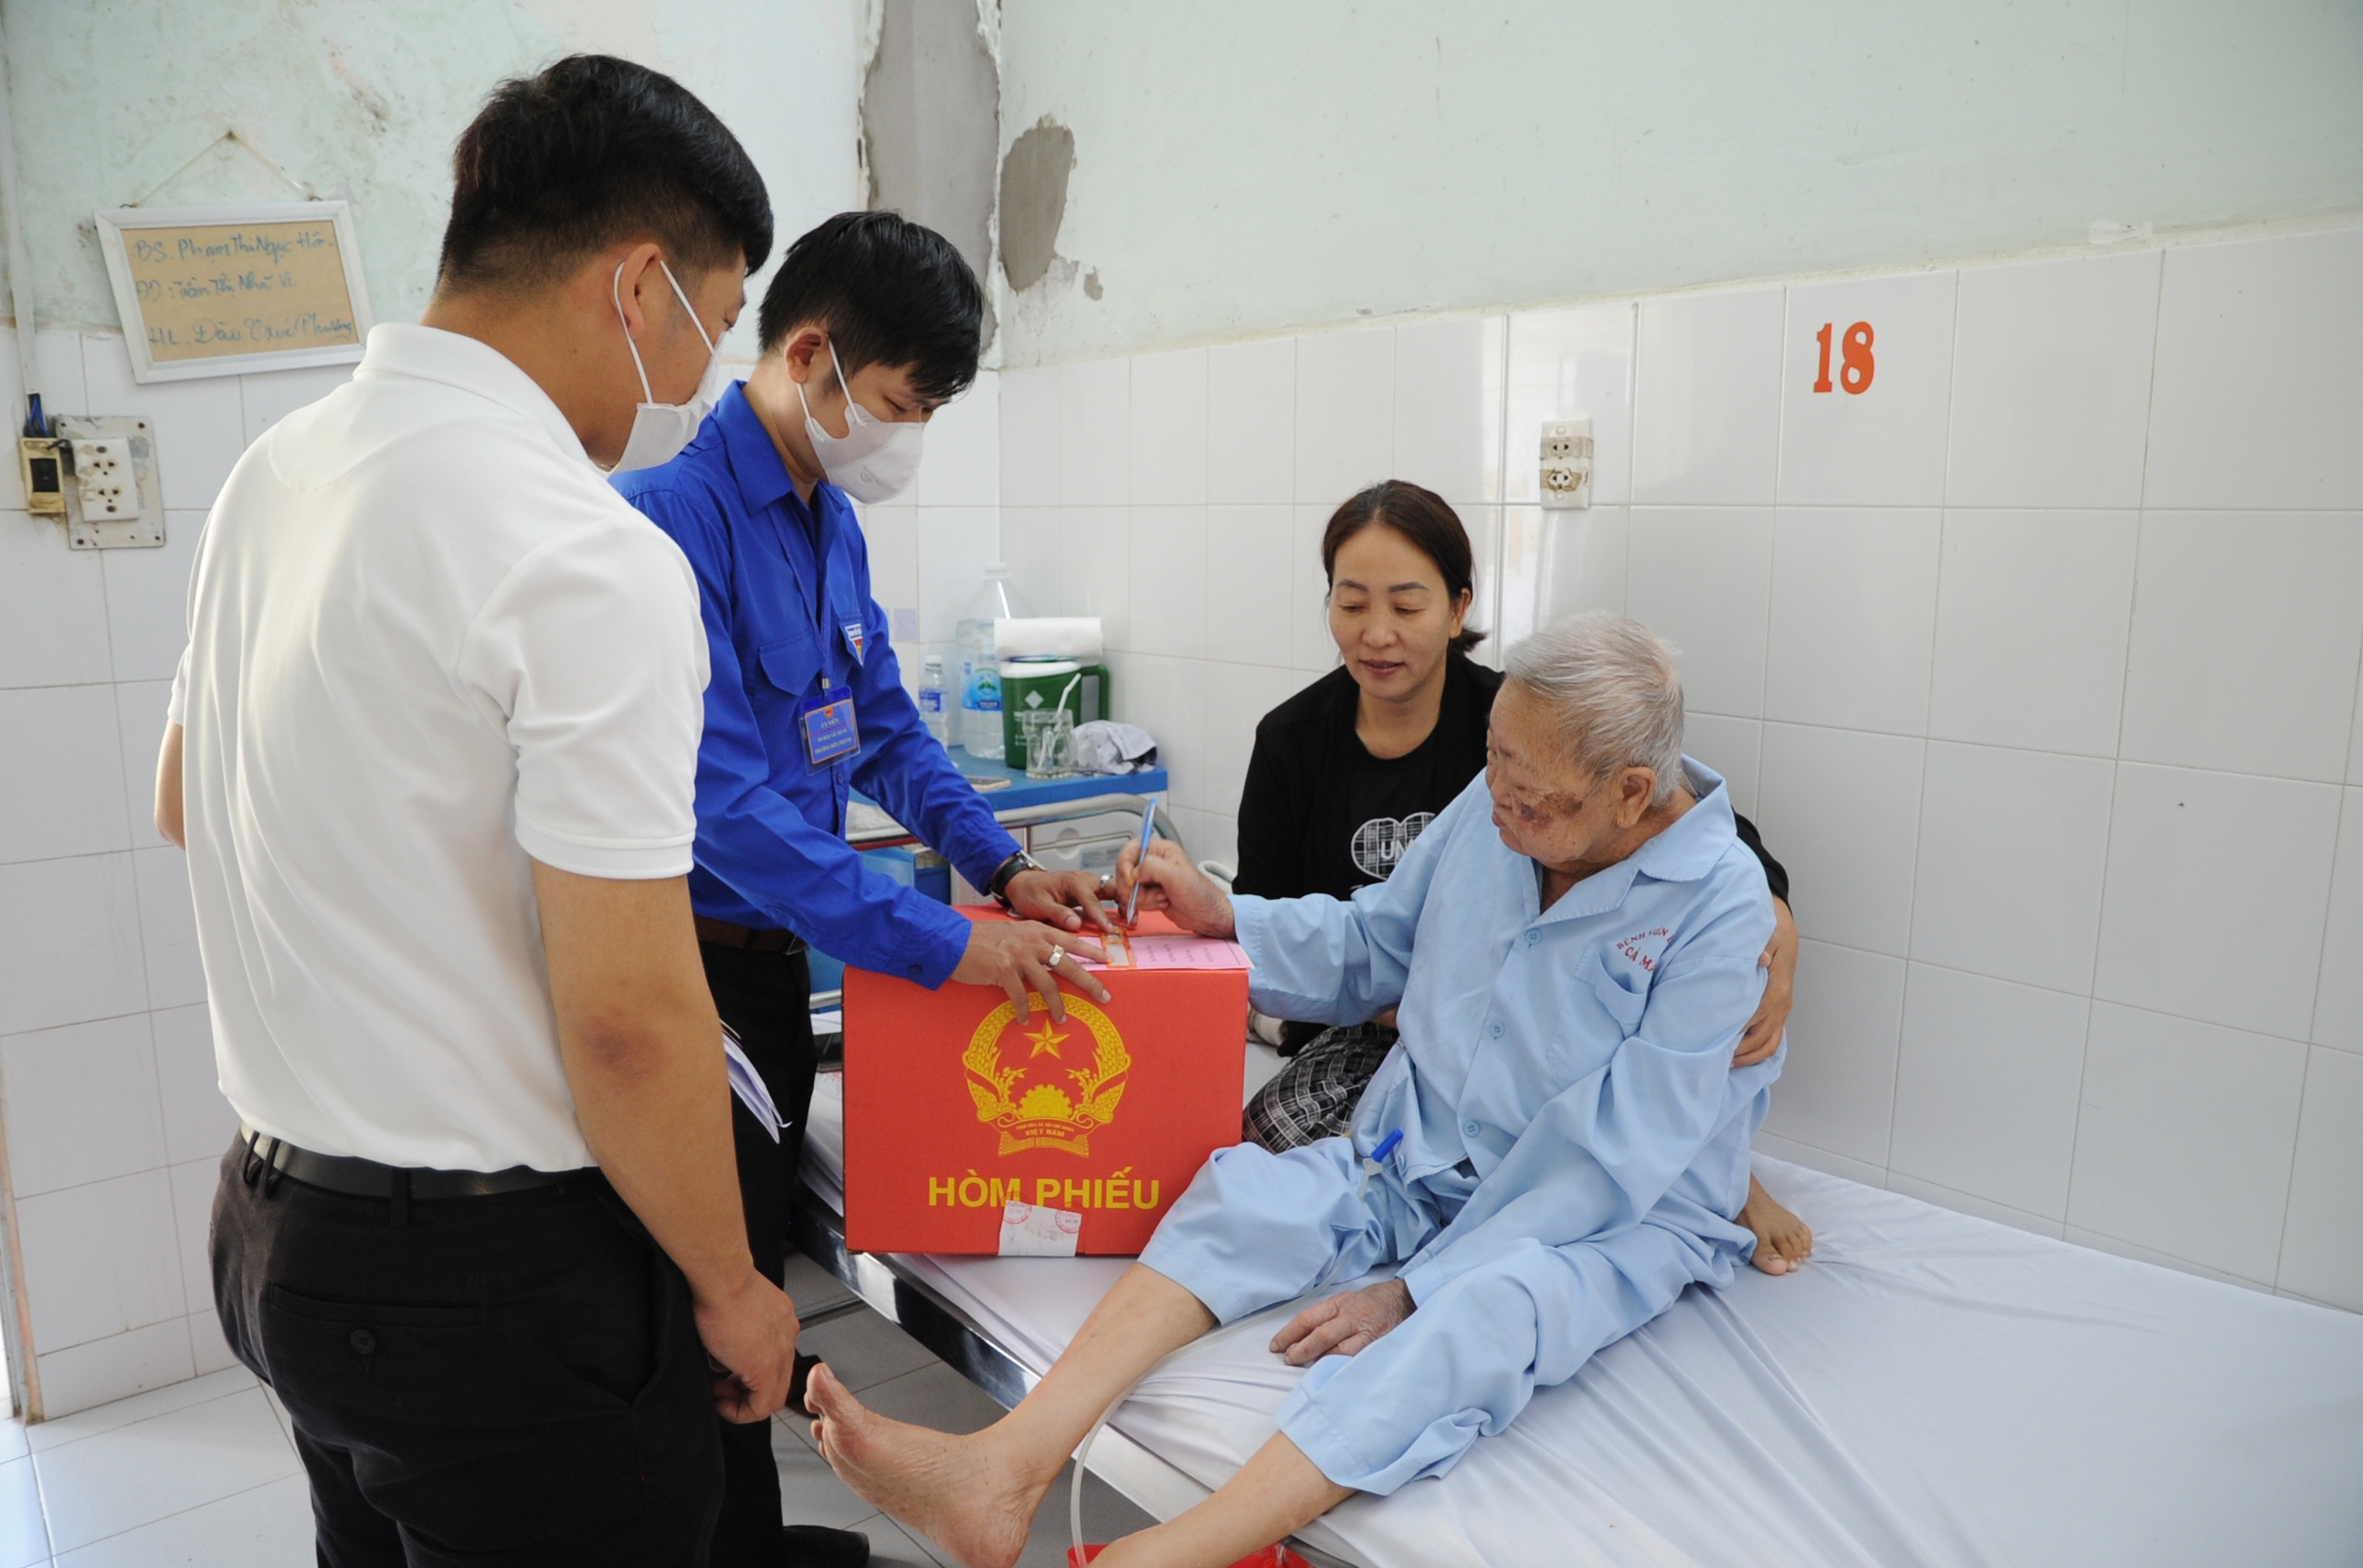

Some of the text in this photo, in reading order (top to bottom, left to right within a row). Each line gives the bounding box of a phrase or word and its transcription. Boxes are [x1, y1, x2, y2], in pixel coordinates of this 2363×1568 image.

[1812, 320, 1876, 396] 18
[929, 1167, 1160, 1210] HÒM PHIẾU
